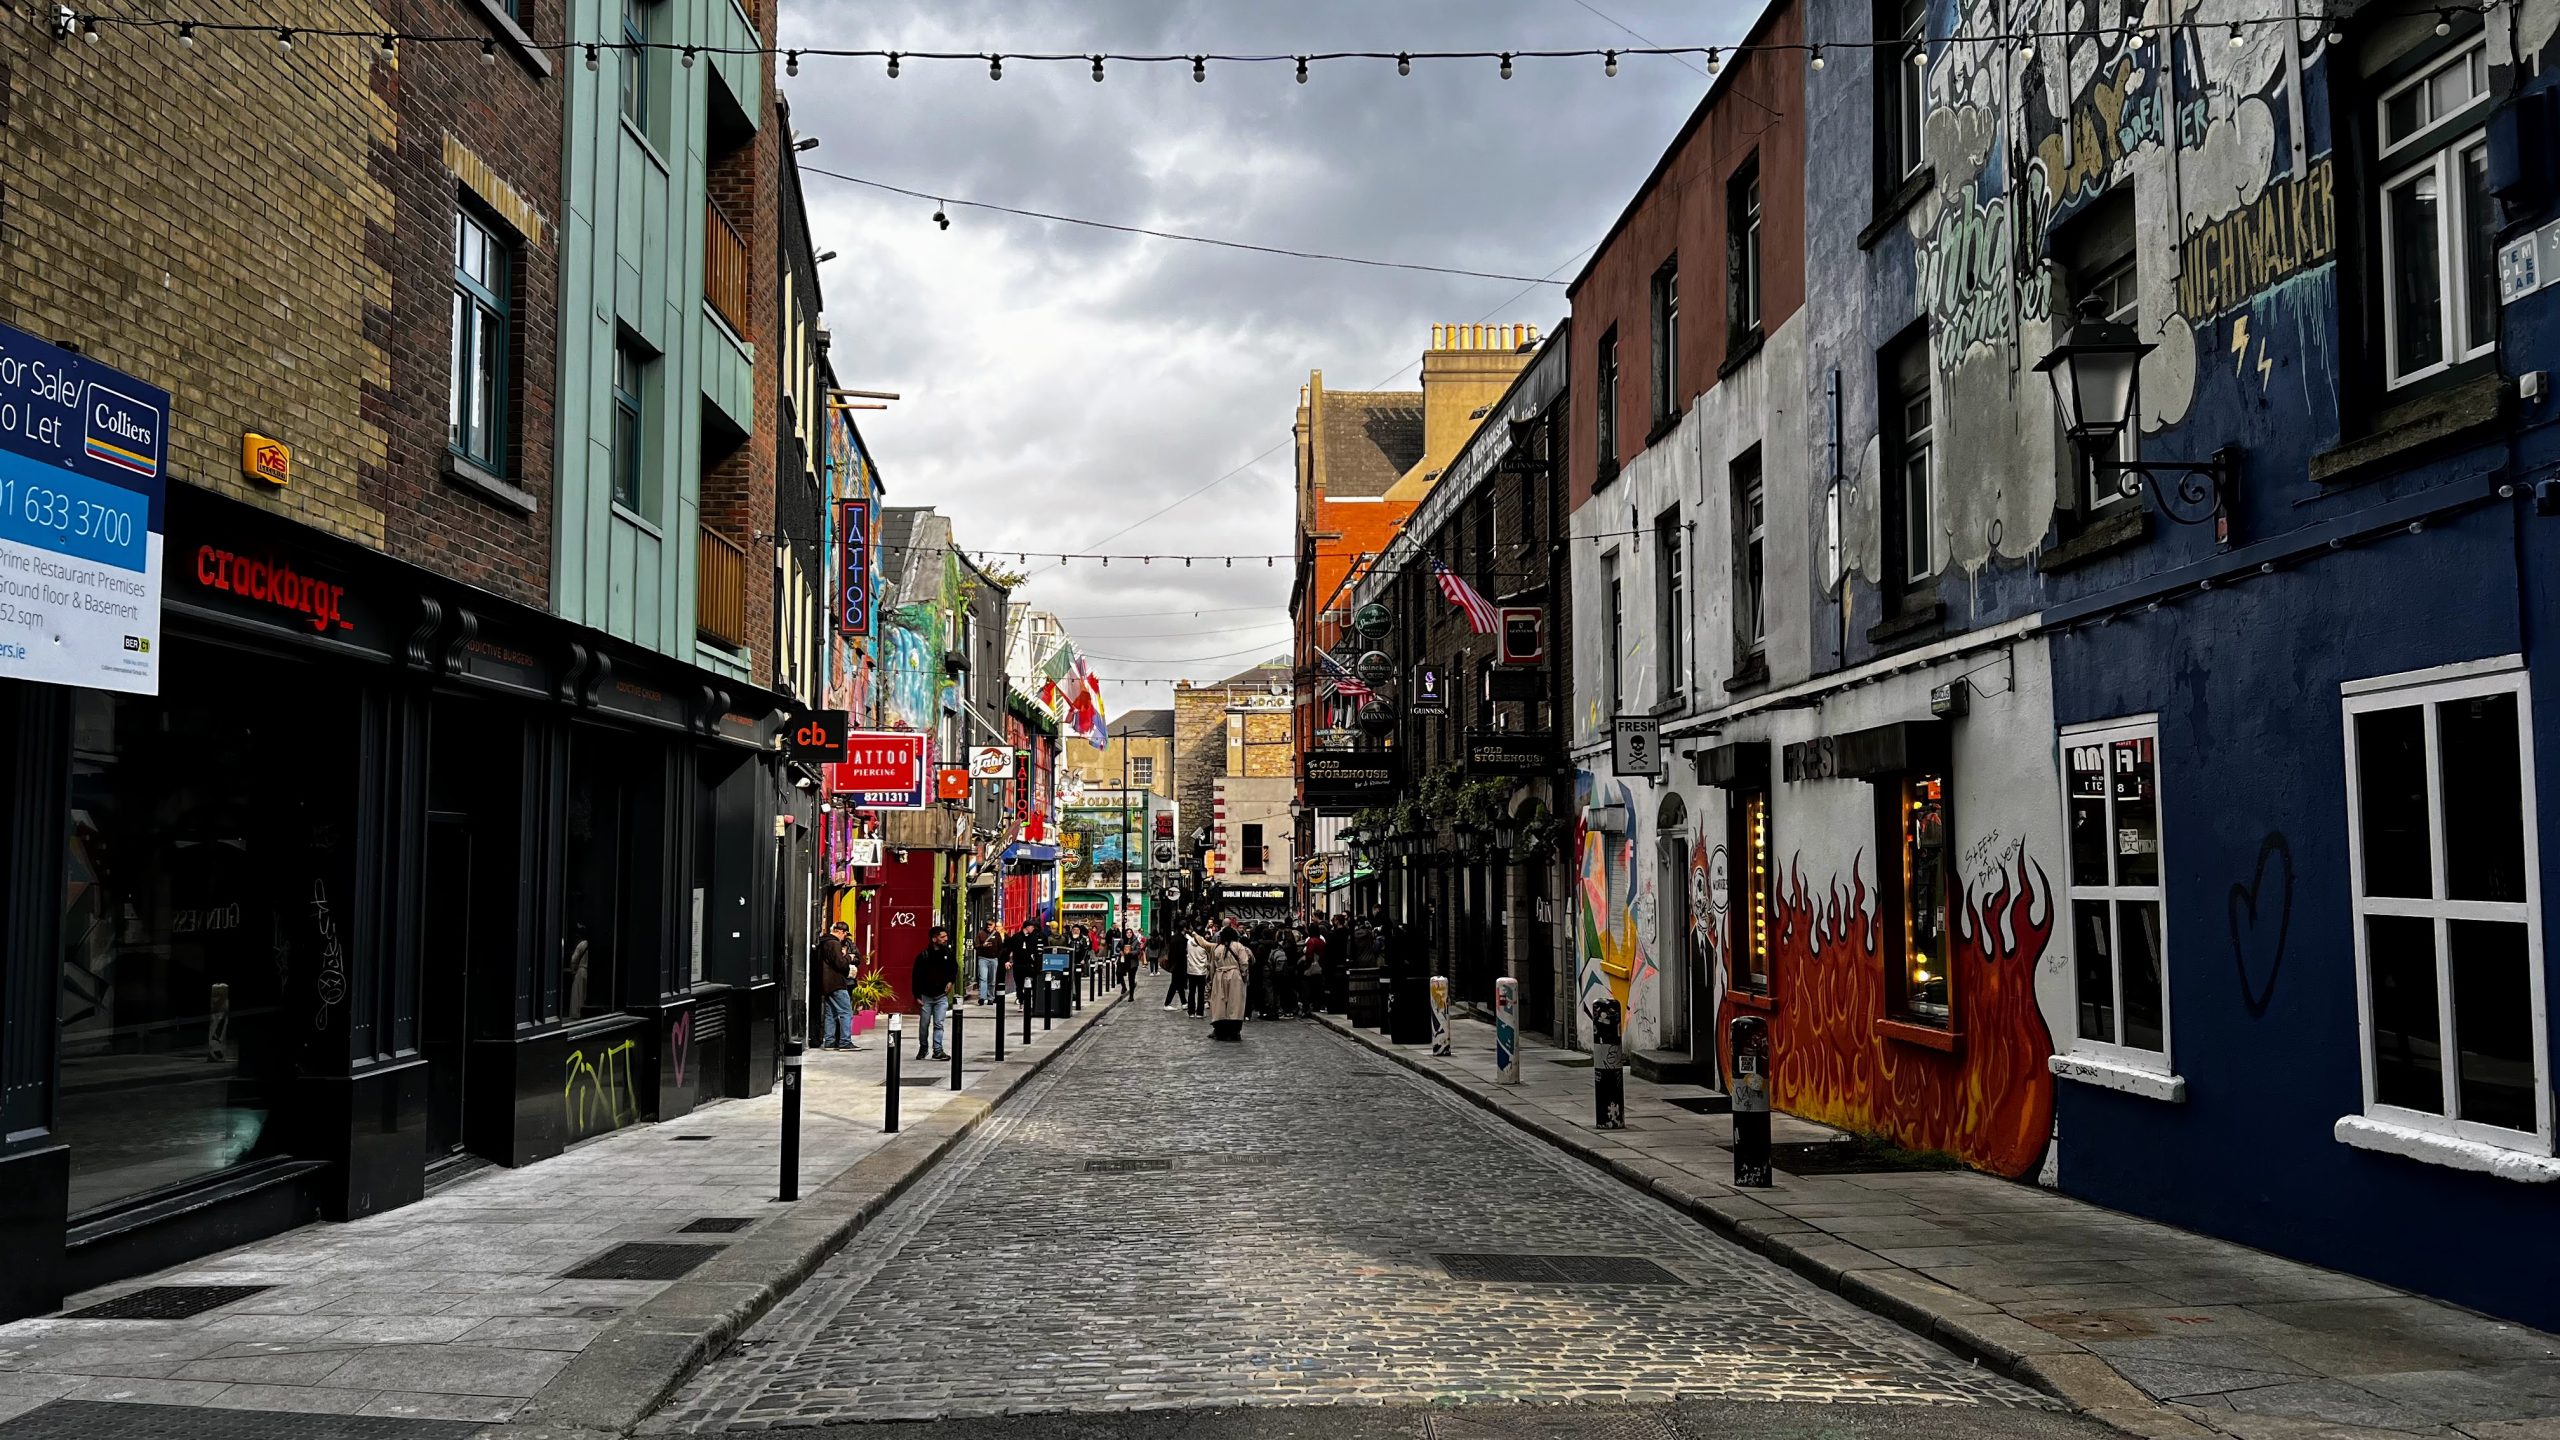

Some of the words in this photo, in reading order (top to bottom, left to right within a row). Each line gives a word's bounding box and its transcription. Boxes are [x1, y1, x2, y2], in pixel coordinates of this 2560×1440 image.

[2119, 86, 2209, 152] DREAER
[2178, 160, 2337, 320] NIGHTWALKER
[2501, 243, 2532, 266] TEM
[2503, 258, 2534, 281] PLE
[2505, 272, 2534, 295] BAR
[31, 361, 84, 408] Sale/
[0, 392, 16, 431] o
[26, 403, 62, 447] Let
[95, 403, 151, 445] Colliers
[25, 486, 69, 530] 633
[75, 500, 132, 547] 3700
[846, 507, 864, 624] TATTOO
[33, 556, 95, 582] Restaurant
[98, 572, 145, 598] Premises
[43, 584, 69, 607] floor
[72, 591, 82, 608] &
[85, 594, 138, 621] Basement
[18, 610, 43, 631] sqm
[125, 638, 138, 649] BER
[140, 641, 149, 650] C1
[1360, 664, 1391, 672] Heineken
[1361, 711, 1393, 720] GUINNESS
[1414, 707, 1445, 715] GUINNESS
[1617, 721, 1656, 732] FRESH
[847, 750, 908, 765] ATTOO
[1483, 746, 1503, 754] OLD
[853, 768, 896, 776] PIERCING
[1309, 769, 1389, 779] STOREHOUSE
[1319, 761, 1340, 769] OLD
[864, 792, 909, 802] 8211311
[1016, 756, 1028, 820] TATTOO
[1087, 797, 1110, 807] OLD
[1222, 890, 1240, 898] DUBLIN
[1241, 890, 1262, 898] VINTAGE
[1262, 890, 1284, 898] FACTORY
